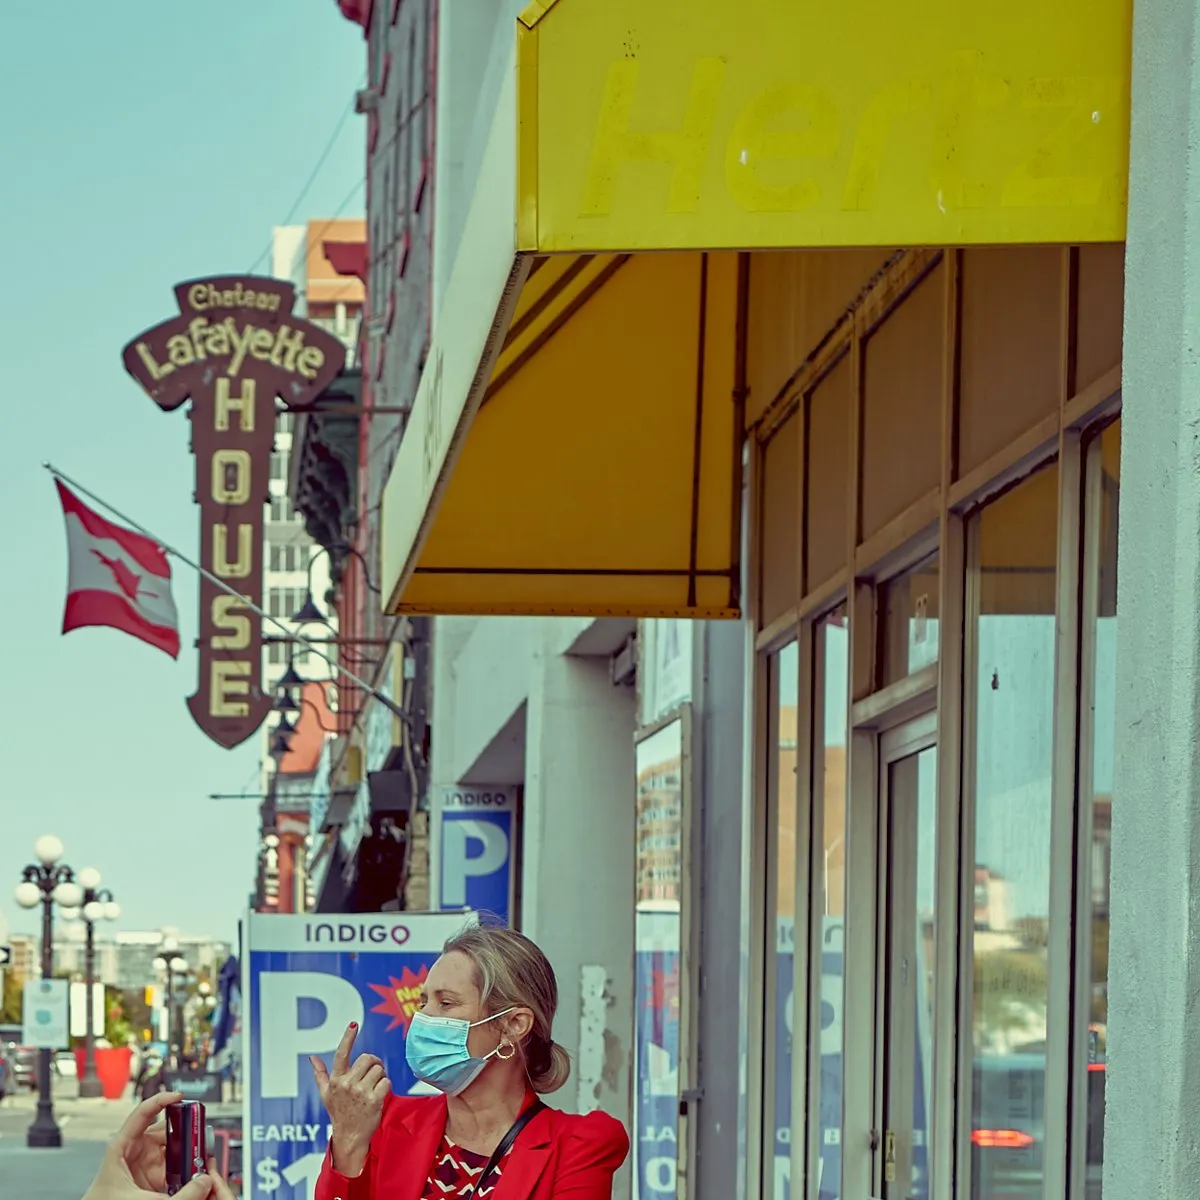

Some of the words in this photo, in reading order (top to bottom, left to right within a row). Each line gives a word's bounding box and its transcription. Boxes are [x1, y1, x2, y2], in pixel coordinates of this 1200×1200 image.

[578, 50, 1120, 218] Hertz
[209, 377, 256, 717] HOUSE
[442, 820, 508, 906] P
[306, 924, 410, 945] INDIGO
[259, 971, 364, 1098] P
[252, 1124, 320, 1142] EARLY
